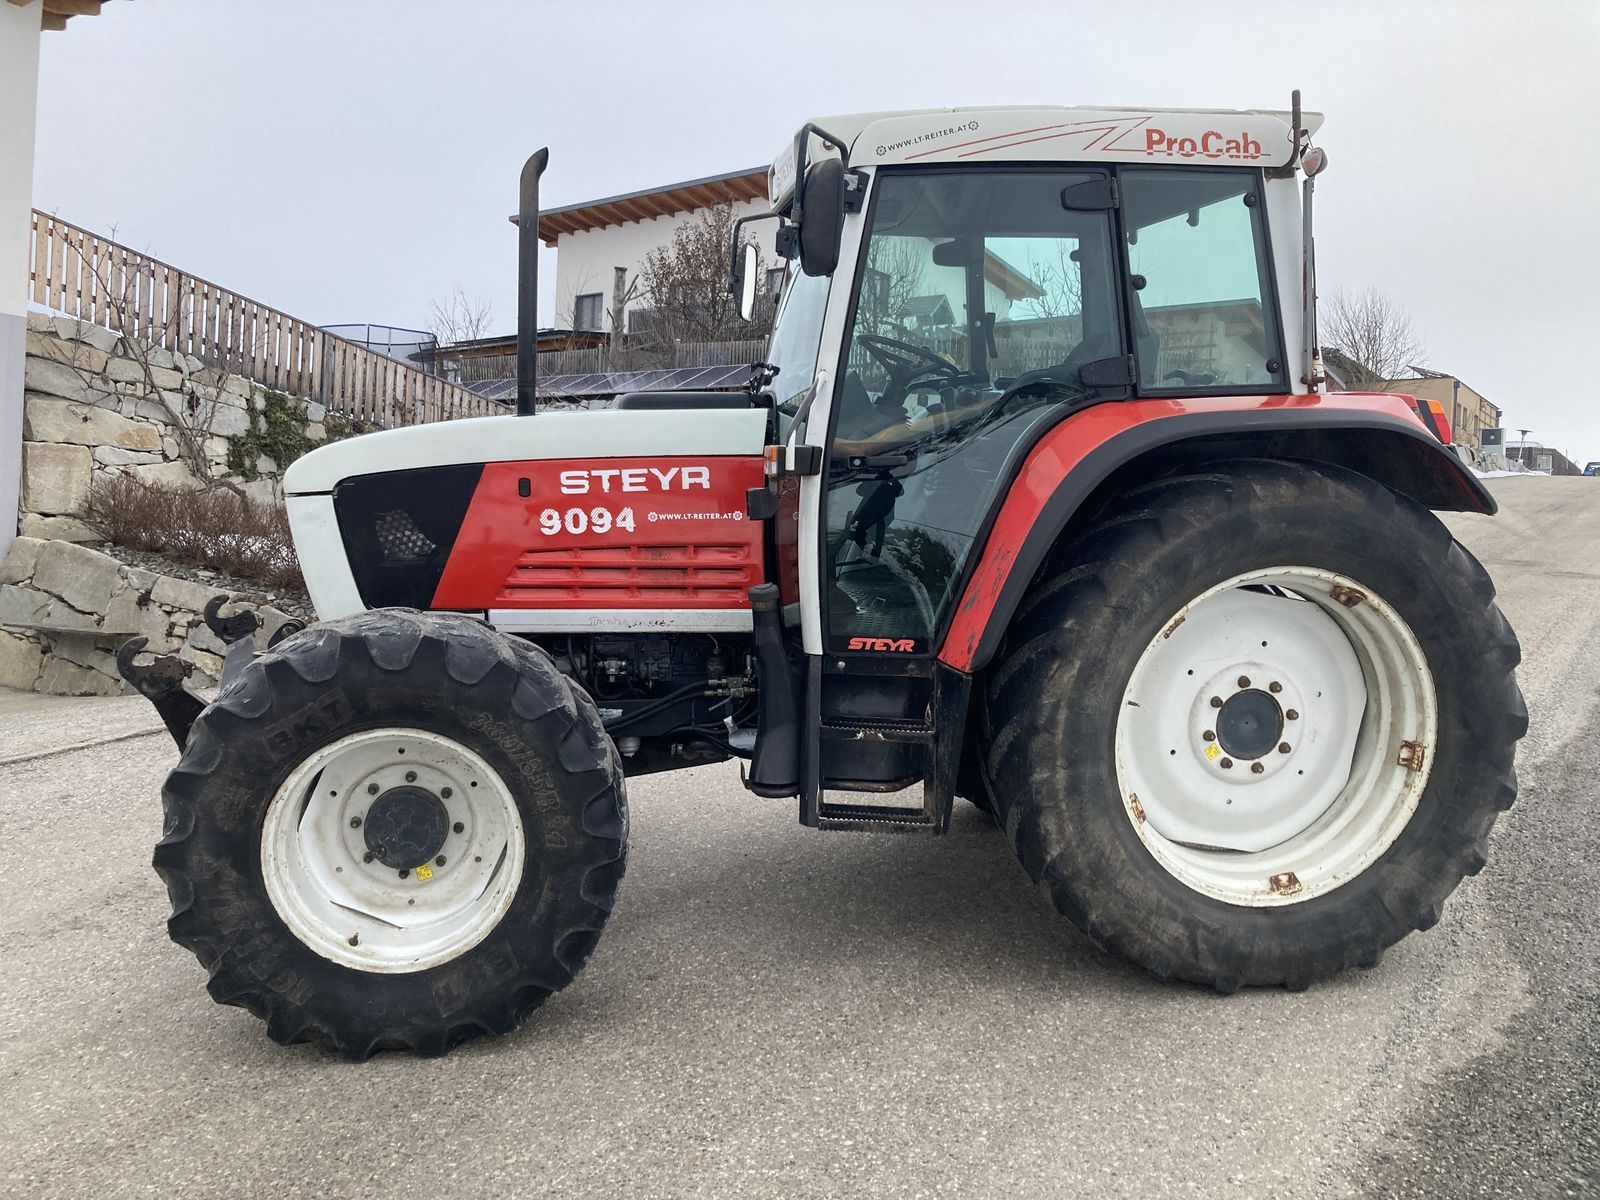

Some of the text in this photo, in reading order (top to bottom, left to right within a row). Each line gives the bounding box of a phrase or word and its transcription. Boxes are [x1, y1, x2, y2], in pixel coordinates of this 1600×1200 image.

[887, 124, 968, 152] WWW.LT-REITER.AT
[560, 466, 711, 495] STEYR
[539, 506, 636, 535] 9094
[659, 512, 732, 520] WWW.LT-REITER.AT
[848, 637, 915, 652] STEYR
